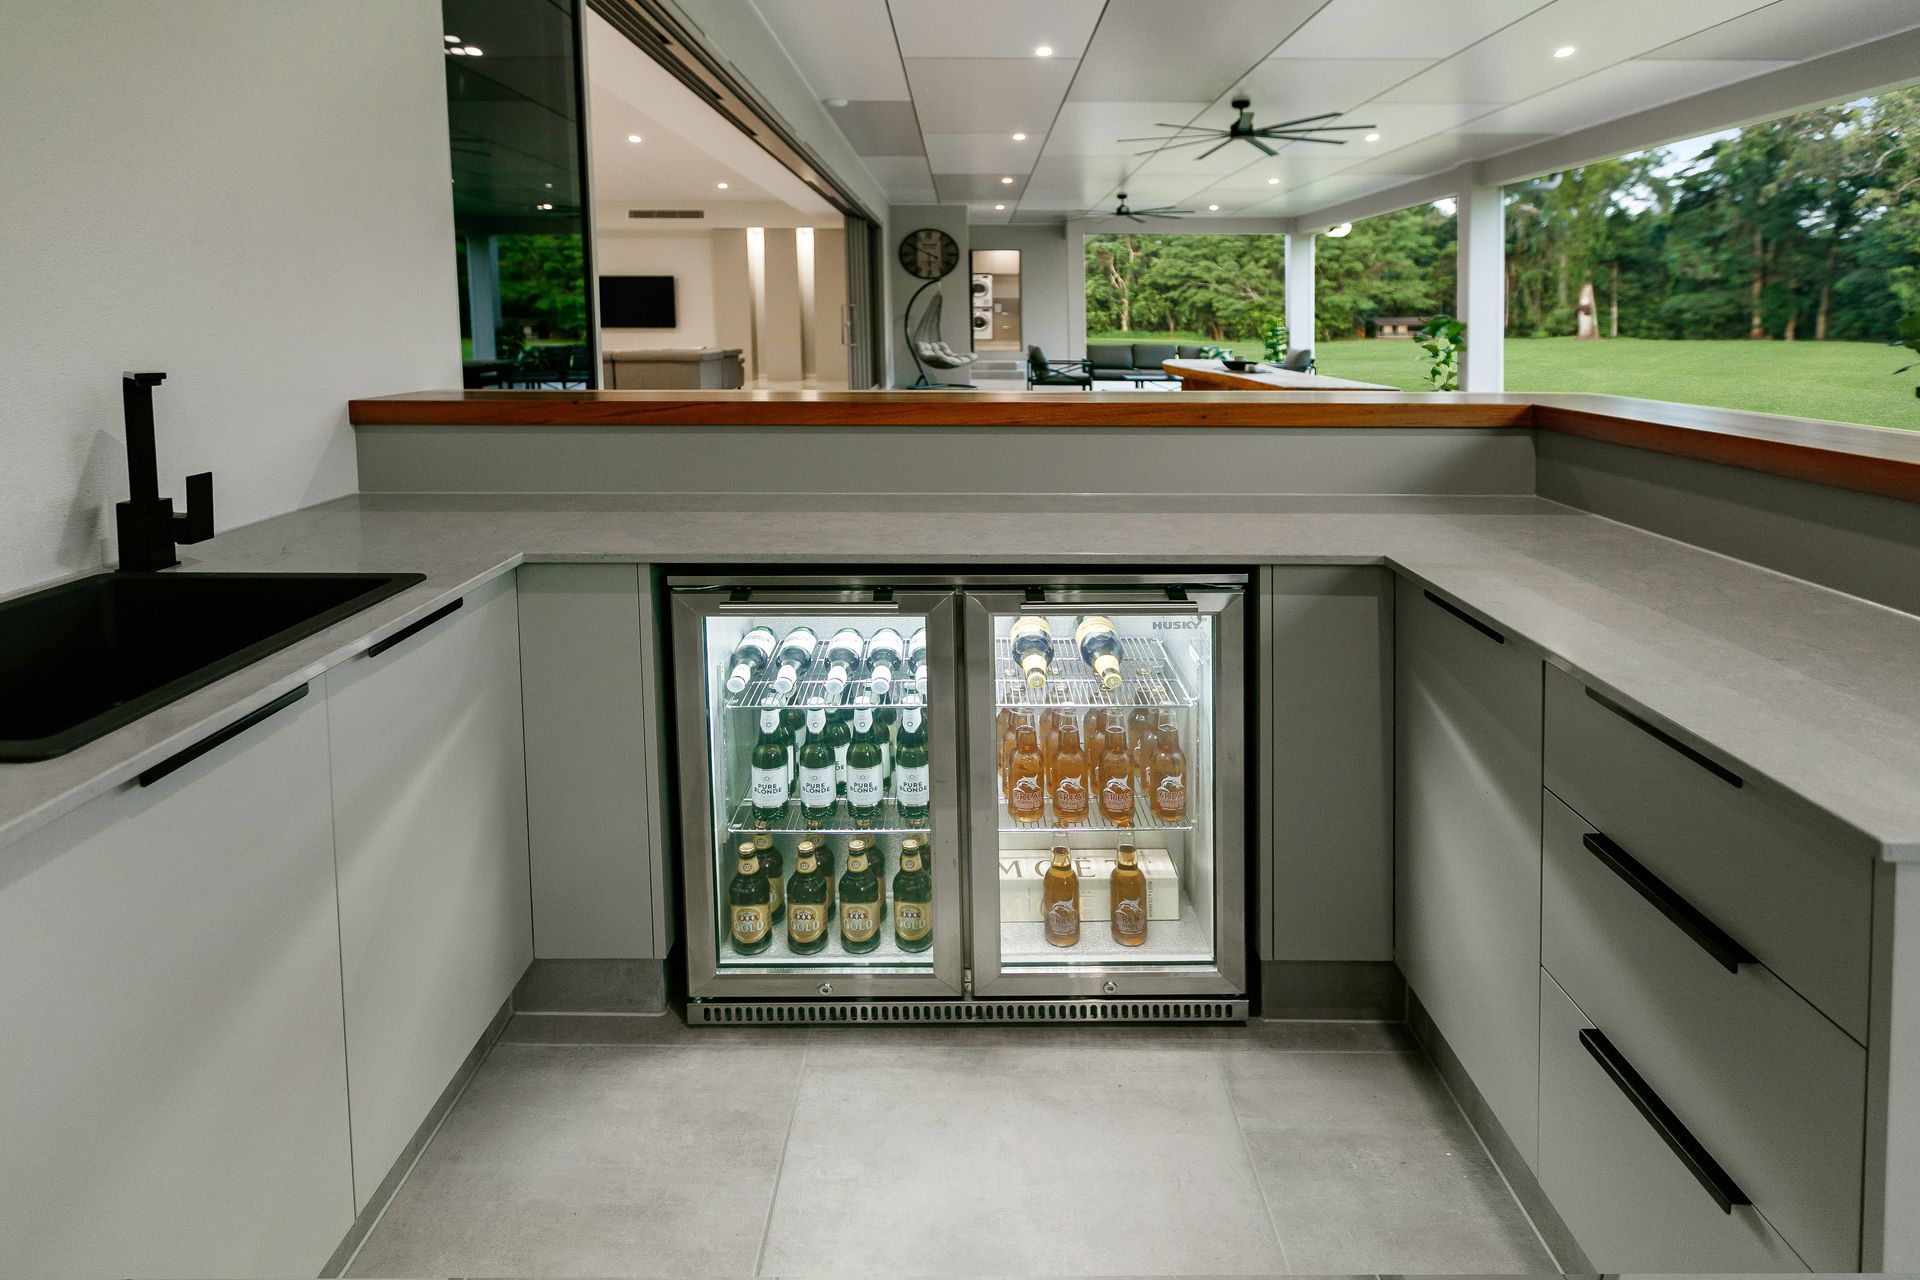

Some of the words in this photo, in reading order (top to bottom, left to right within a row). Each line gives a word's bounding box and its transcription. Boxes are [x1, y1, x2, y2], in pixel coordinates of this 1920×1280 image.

[1152, 620, 1202, 630] HUSKY
[754, 787, 782, 795] BLONDE
[802, 786, 830, 794] BLONDE
[850, 785, 878, 793] BLONDE
[900, 785, 928, 793] BLONDE
[733, 921, 764, 932] GOLD
[790, 920, 820, 931] GOLD
[844, 919, 873, 930] GOLD
[897, 918, 926, 929] GOLD
